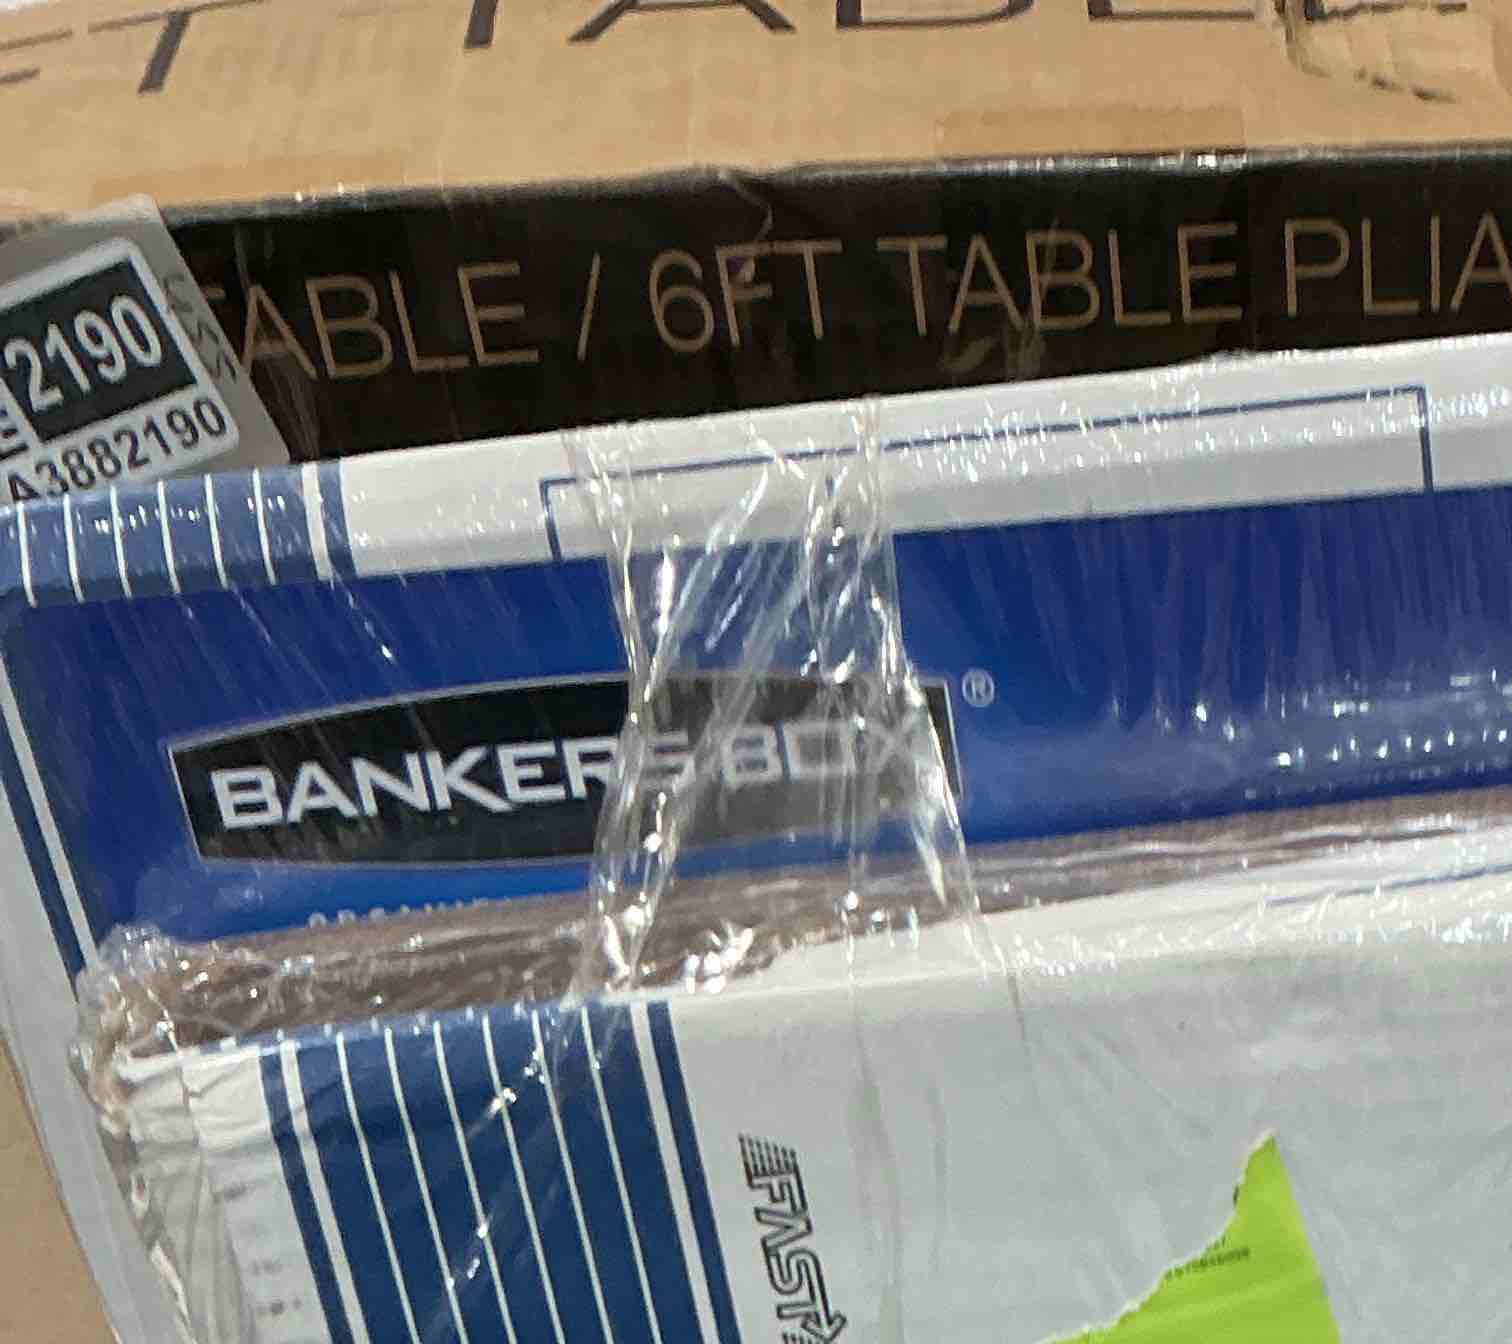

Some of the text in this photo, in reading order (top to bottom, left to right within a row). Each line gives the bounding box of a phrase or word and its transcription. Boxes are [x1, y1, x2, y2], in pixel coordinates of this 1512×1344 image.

[203, 260, 540, 380] ABLE
[648, 239, 843, 354] 6FT
[877, 221, 1243, 338] TABLE
[210, 732, 697, 830] BANKERS
